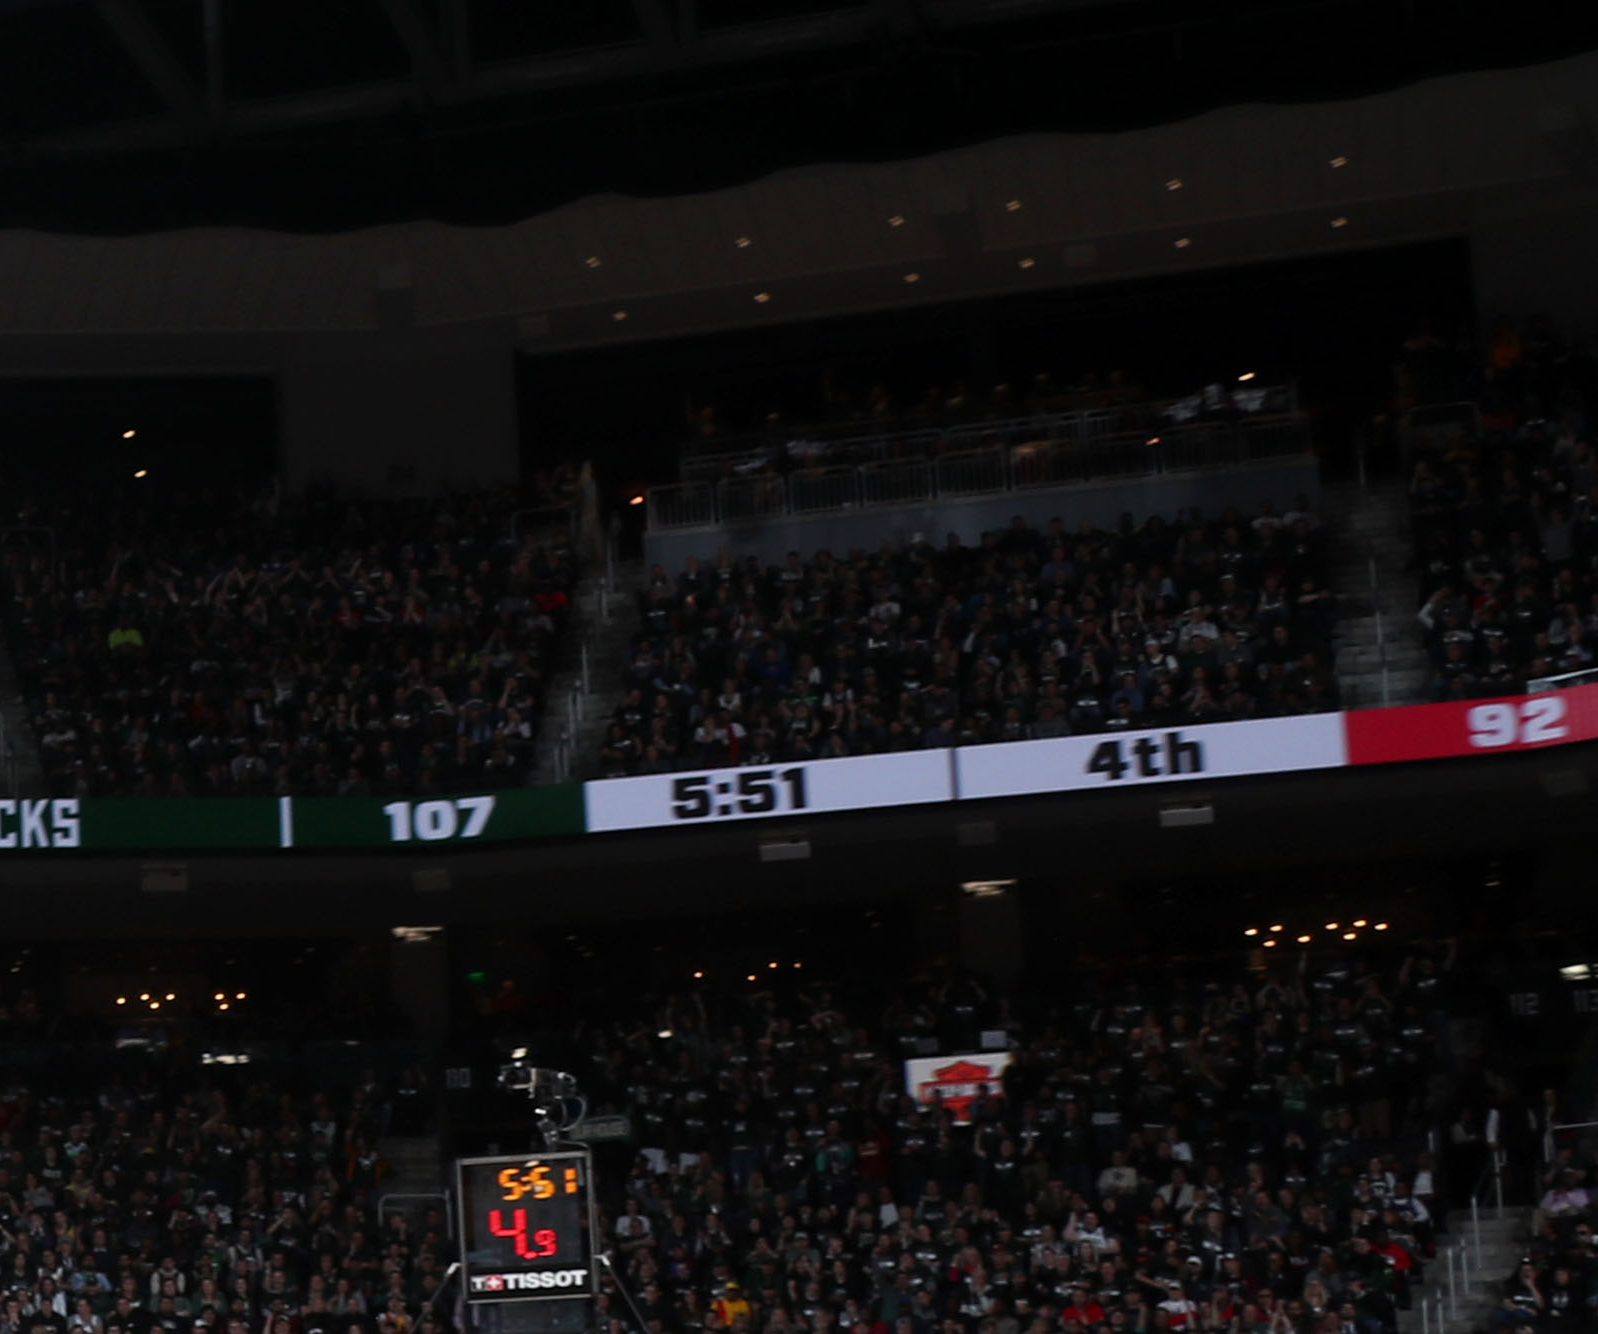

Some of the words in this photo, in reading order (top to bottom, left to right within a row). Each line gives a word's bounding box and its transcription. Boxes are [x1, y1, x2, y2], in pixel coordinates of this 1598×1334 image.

[1467, 696, 1570, 748] 92
[1085, 730, 1205, 781] 4th
[384, 796, 495, 841] 107
[672, 767, 808, 819] 5:51
[497, 1166, 578, 1201] 5:51
[488, 1208, 557, 1260] 4.9
[502, 1269, 588, 1290] TISSOT
